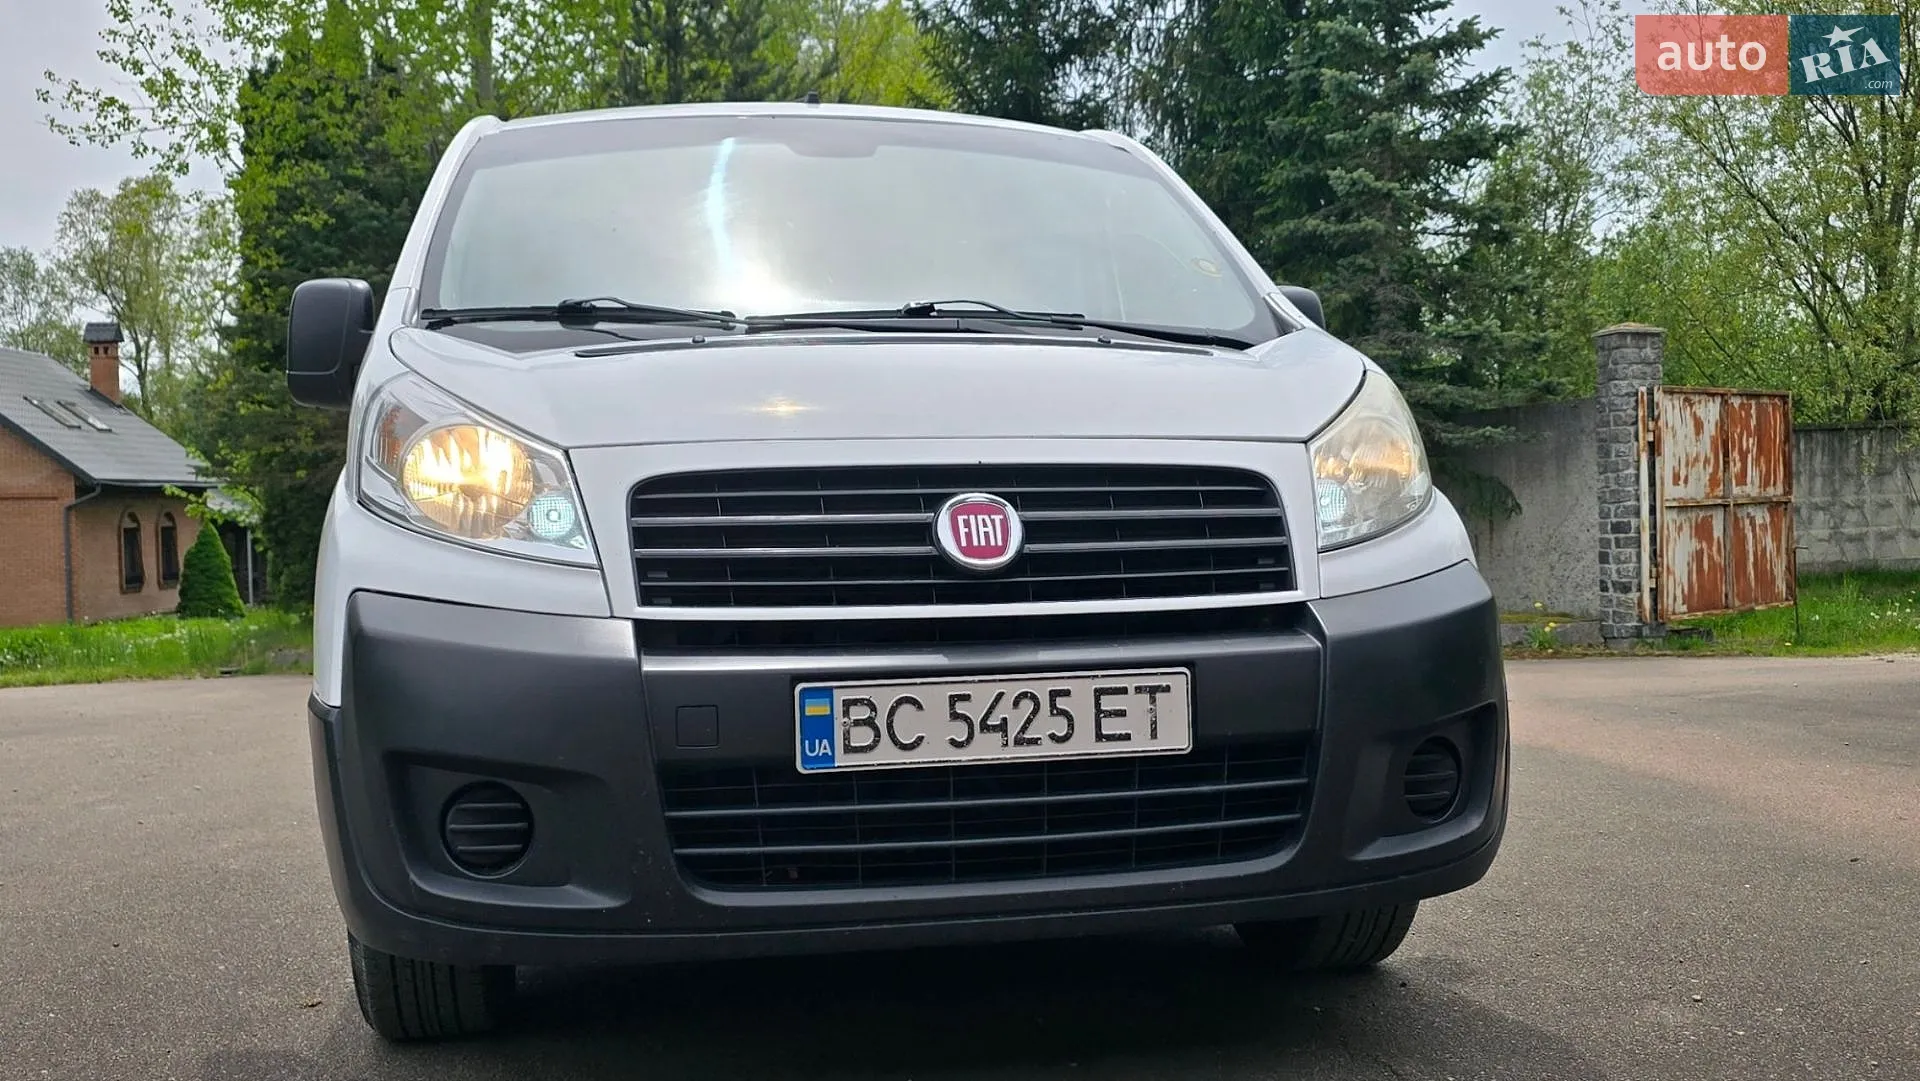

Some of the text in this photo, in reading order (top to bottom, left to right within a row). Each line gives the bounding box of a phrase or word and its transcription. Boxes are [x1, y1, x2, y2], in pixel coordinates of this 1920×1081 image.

[957, 514, 1004, 547] FIAT
[841, 684, 1172, 755] BC 5425 ET
[805, 739, 833, 757] UA
